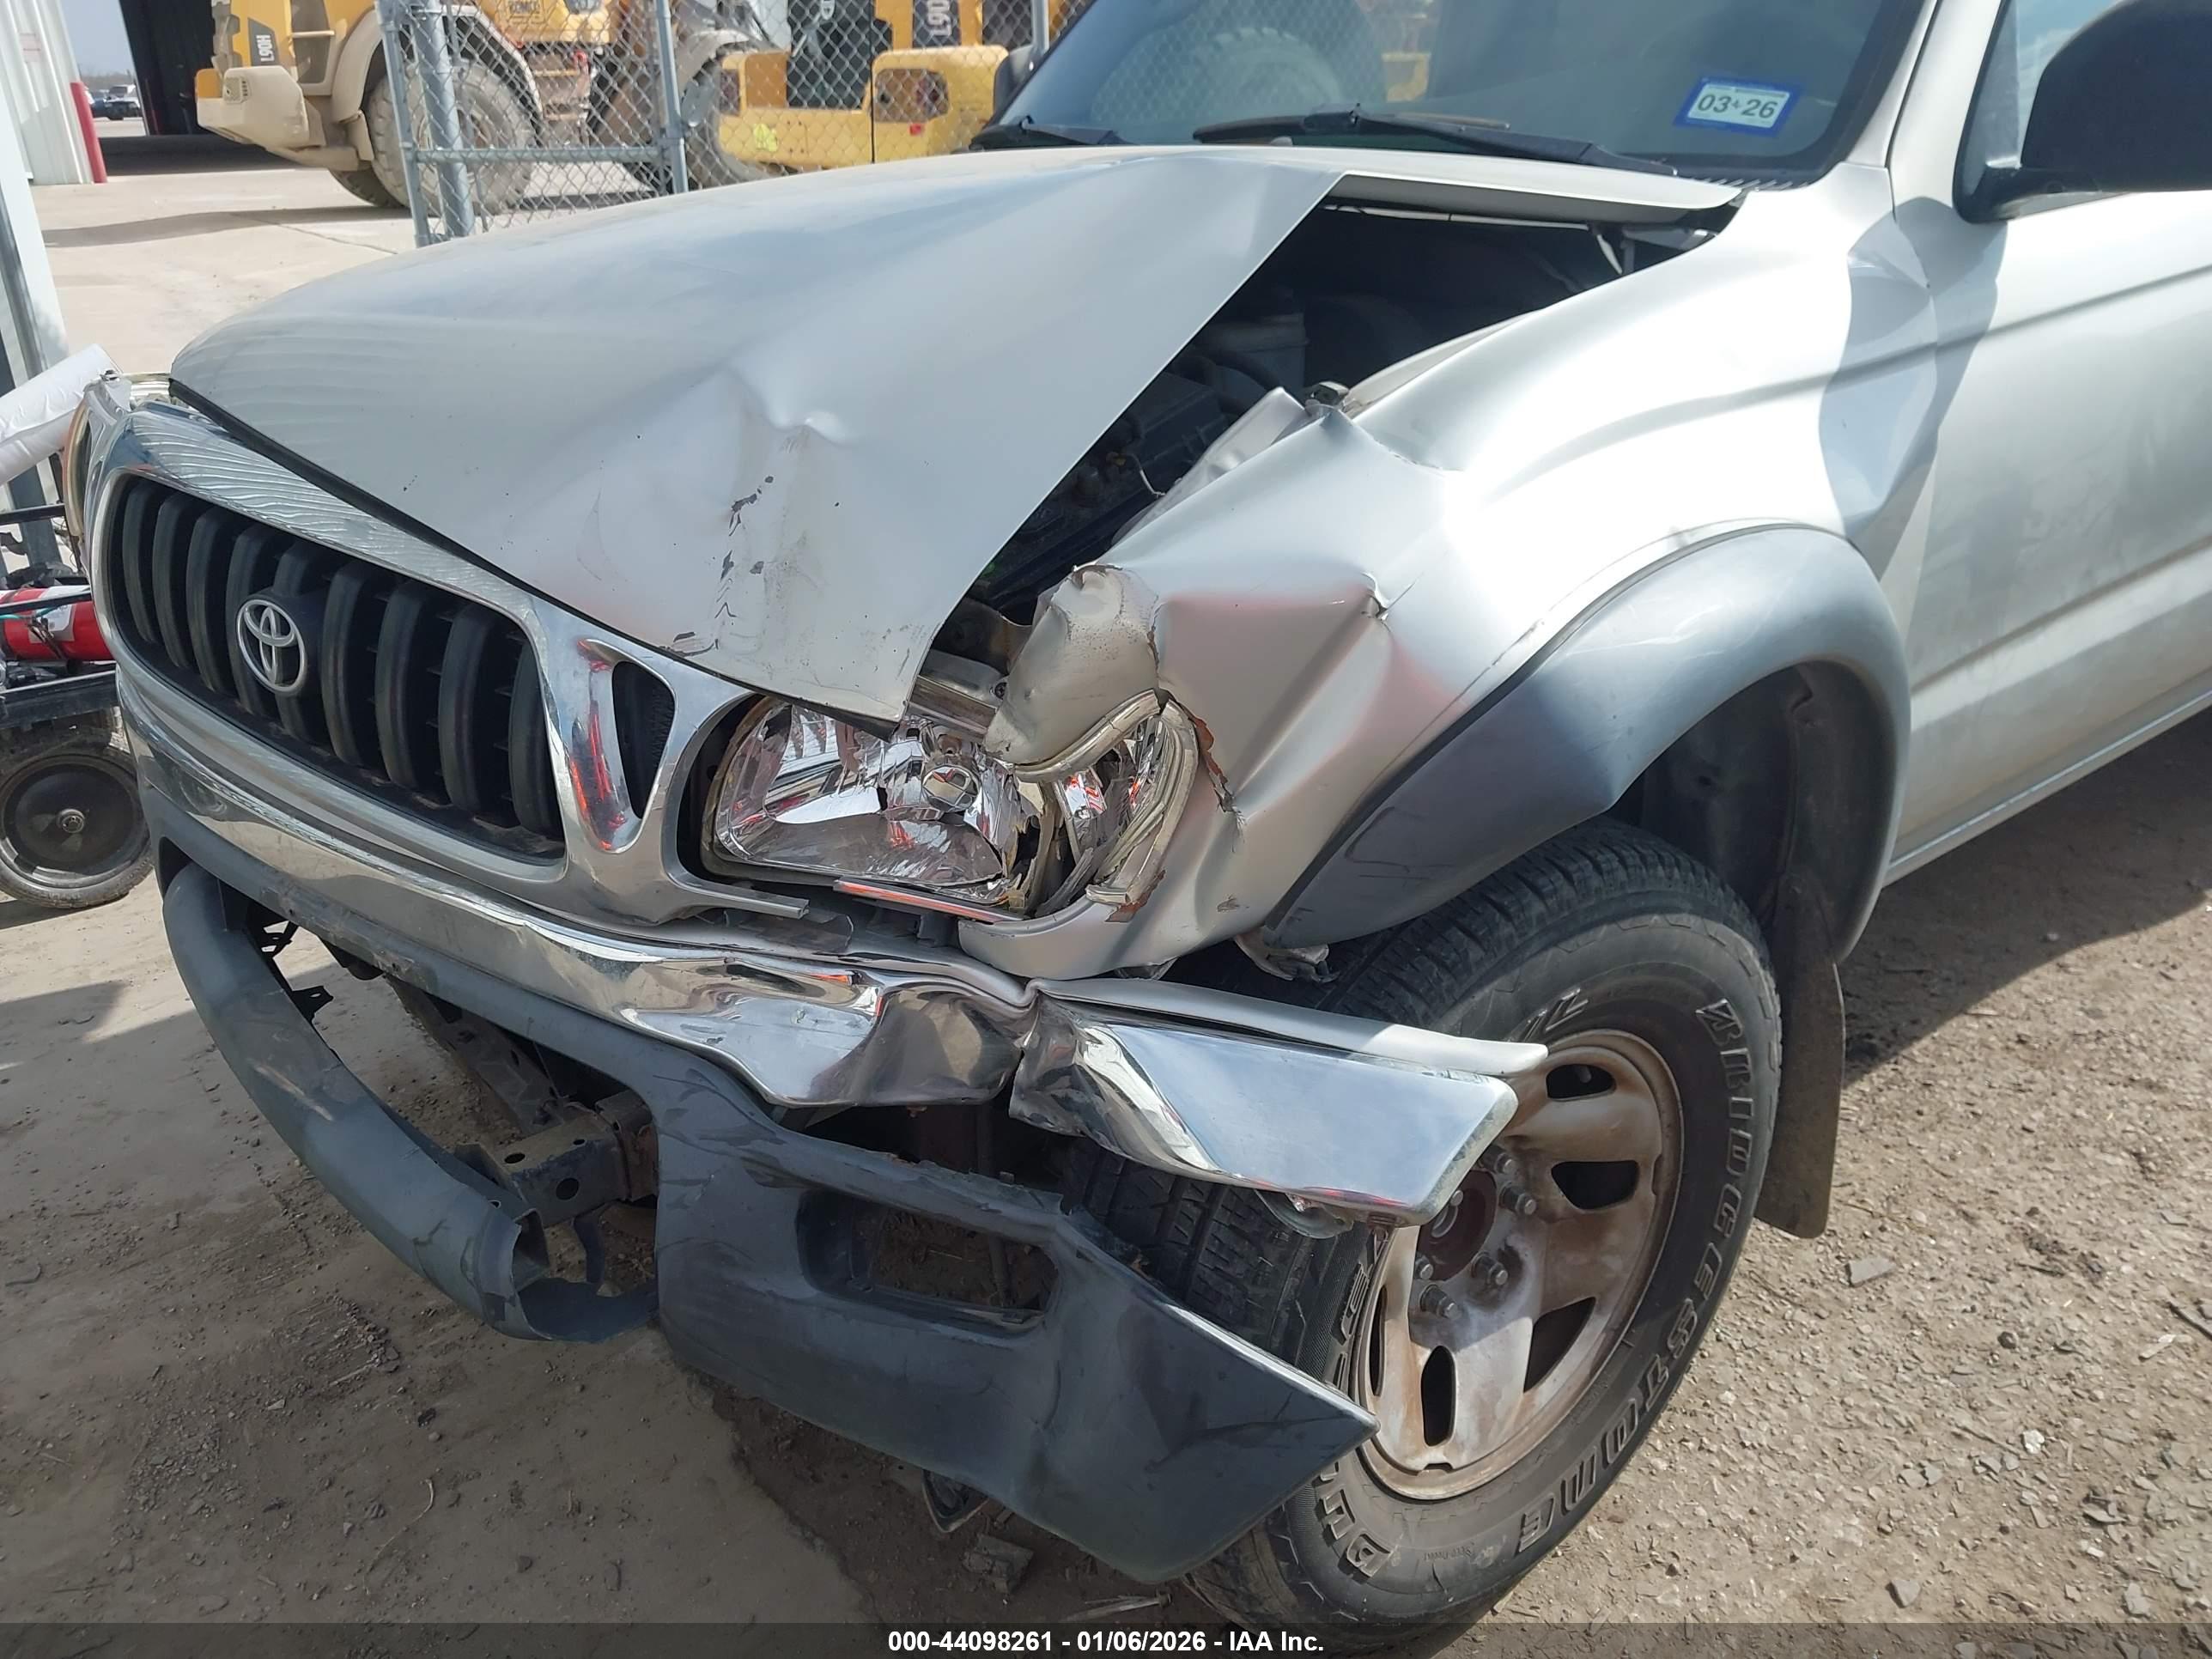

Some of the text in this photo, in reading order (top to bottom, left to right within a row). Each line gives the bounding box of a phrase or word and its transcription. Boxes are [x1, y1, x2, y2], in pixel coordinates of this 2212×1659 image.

[256, 34, 276, 62] L90H
[1698, 94, 1778, 118] 03 26
[1516, 998, 1753, 1553] BRIDGESTONE
